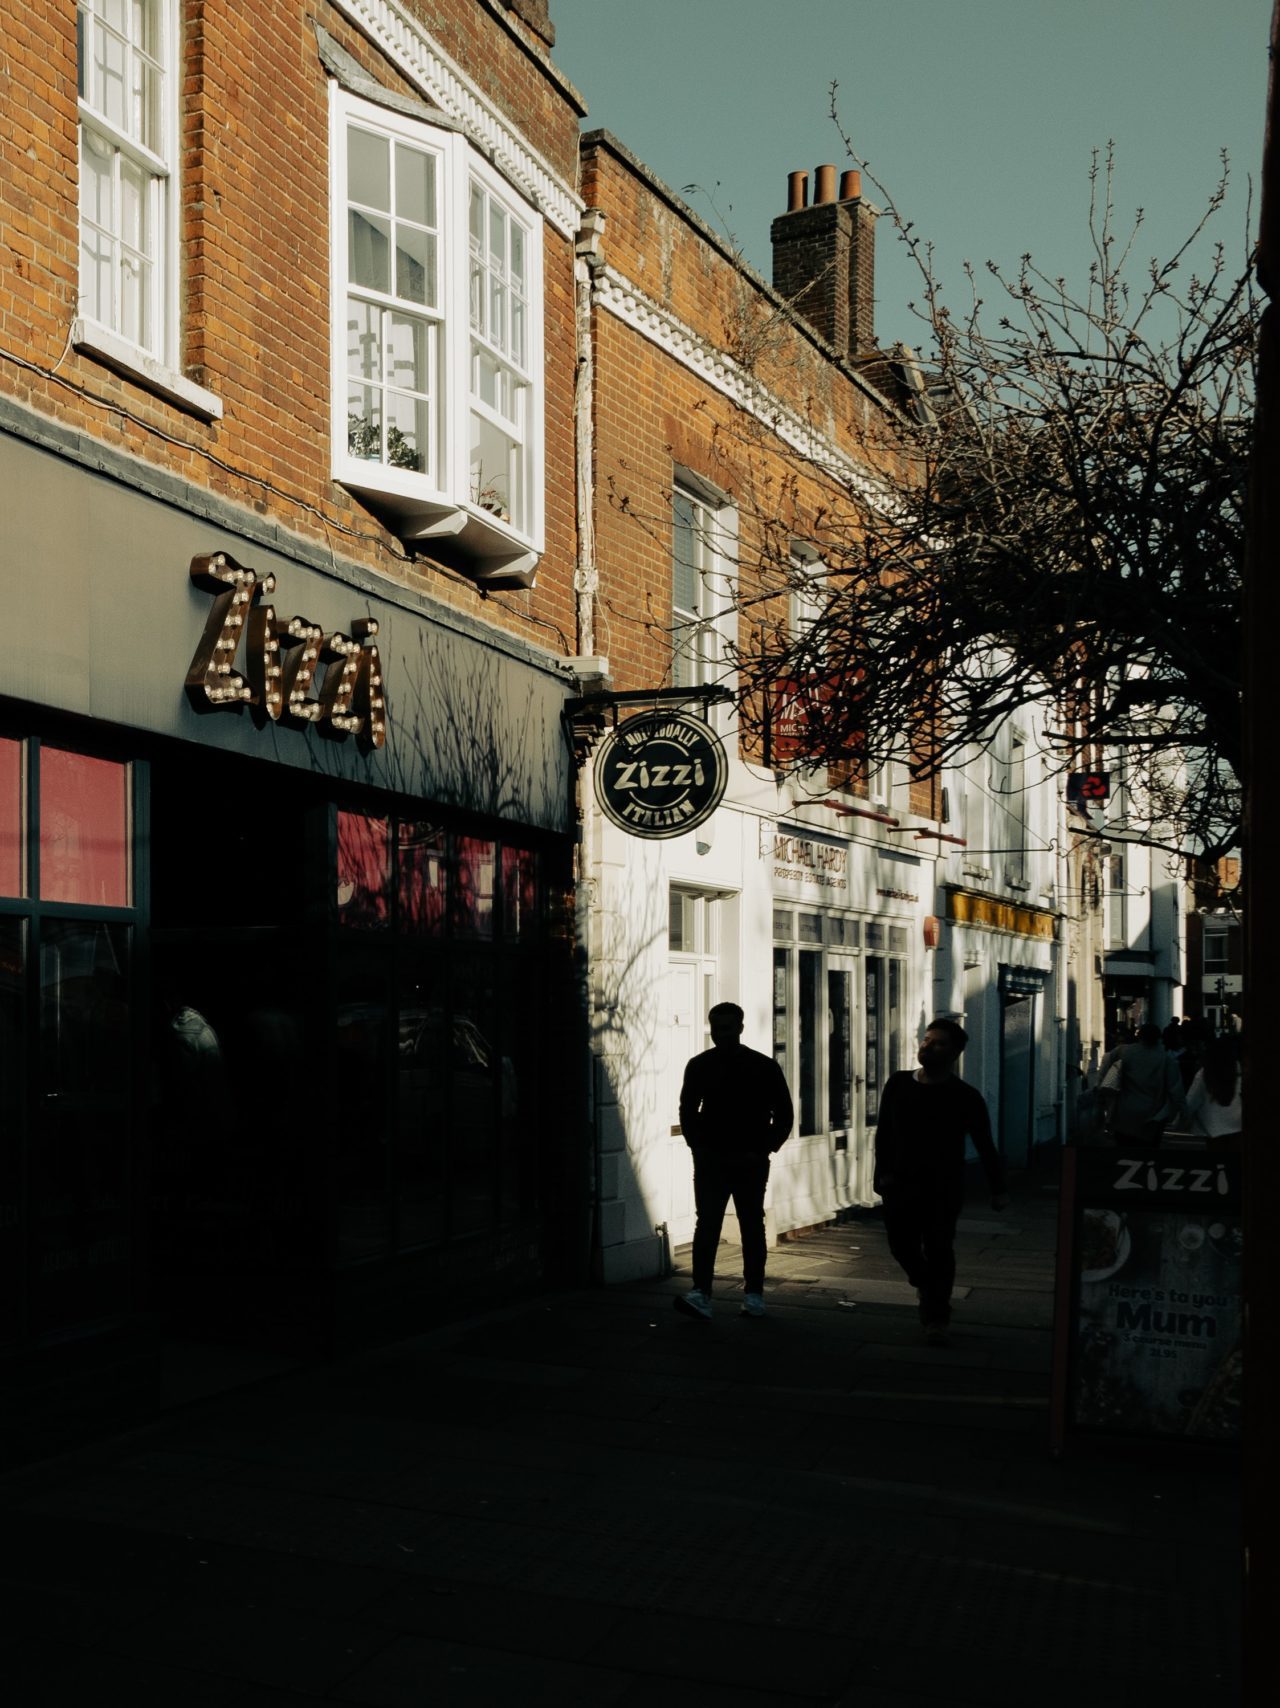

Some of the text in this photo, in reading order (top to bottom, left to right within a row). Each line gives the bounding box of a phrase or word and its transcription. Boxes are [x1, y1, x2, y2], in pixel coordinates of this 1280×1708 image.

[184, 550, 385, 757] Zizzi
[619, 723, 701, 752] NDIVIDUALLY
[613, 758, 705, 789] Zizzi
[622, 799, 696, 826] ITALIAN
[1112, 1158, 1230, 1196] Zizzi
[1108, 1283, 1227, 1309] Here's to you
[1116, 1301, 1217, 1338] Mum
